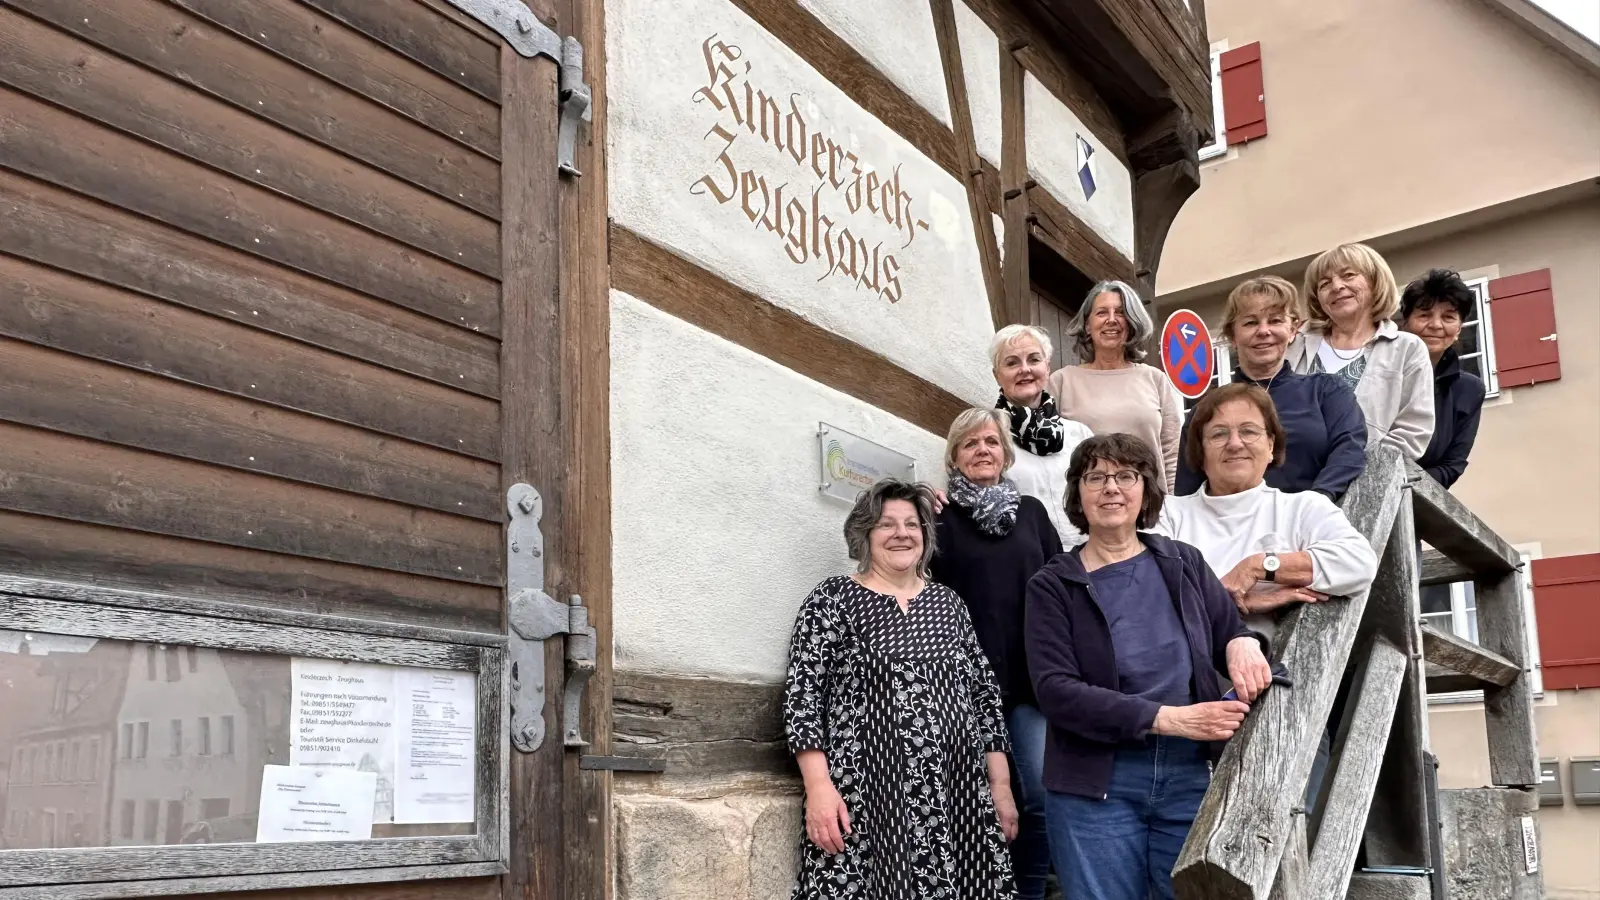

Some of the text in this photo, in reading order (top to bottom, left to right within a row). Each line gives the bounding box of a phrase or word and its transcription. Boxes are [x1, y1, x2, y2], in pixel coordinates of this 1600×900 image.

[691, 33, 930, 250] Kinderzech-
[689, 122, 903, 304] Zeughaus
[325, 736, 346, 744] Service
[333, 692, 347, 700] nach
